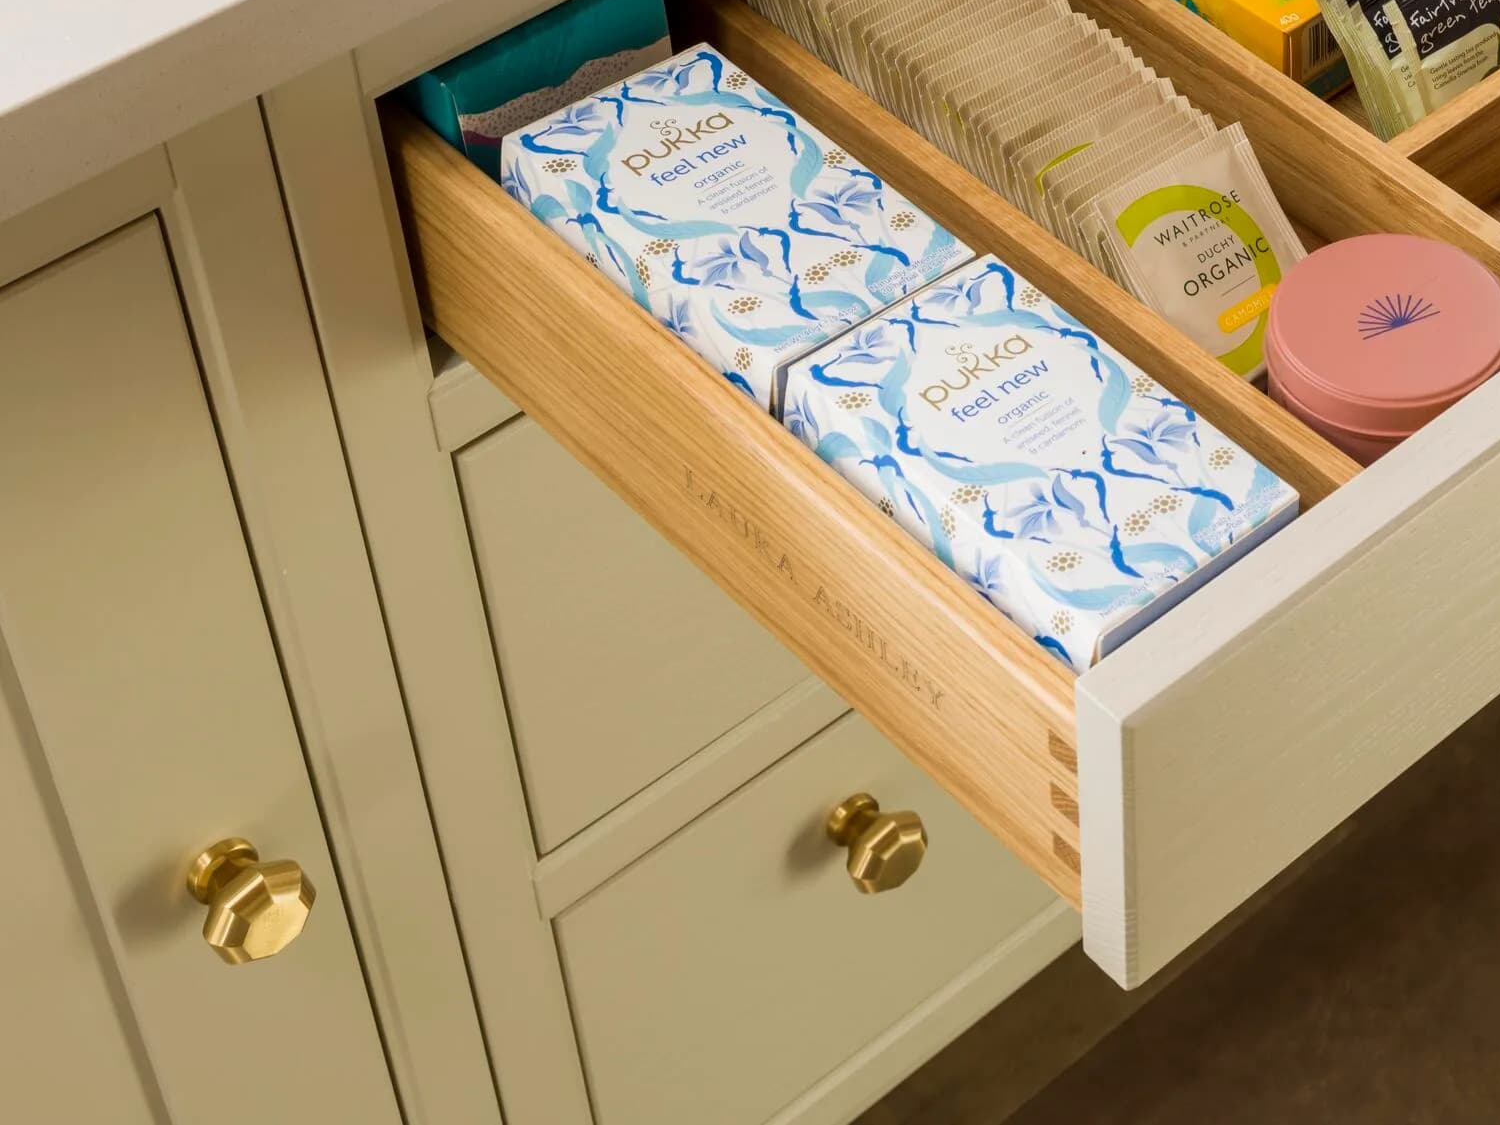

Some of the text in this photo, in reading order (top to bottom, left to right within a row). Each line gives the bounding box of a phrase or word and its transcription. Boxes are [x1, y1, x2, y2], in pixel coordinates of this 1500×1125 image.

[1420, 13, 1467, 54] green
[621, 112, 735, 177] pukka
[650, 133, 748, 187] feel new
[694, 158, 746, 190] organic
[730, 173, 754, 191] fusion
[755, 166, 769, 178] of
[1153, 189, 1241, 247] WAITROSE
[1189, 215, 1231, 243] PARTNERS
[1183, 236, 1270, 297] ORGANIC
[1197, 234, 1237, 264] DUCHY
[918, 334, 1035, 412] pukka
[950, 358, 1049, 423] feel new
[997, 390, 1051, 425] organic
